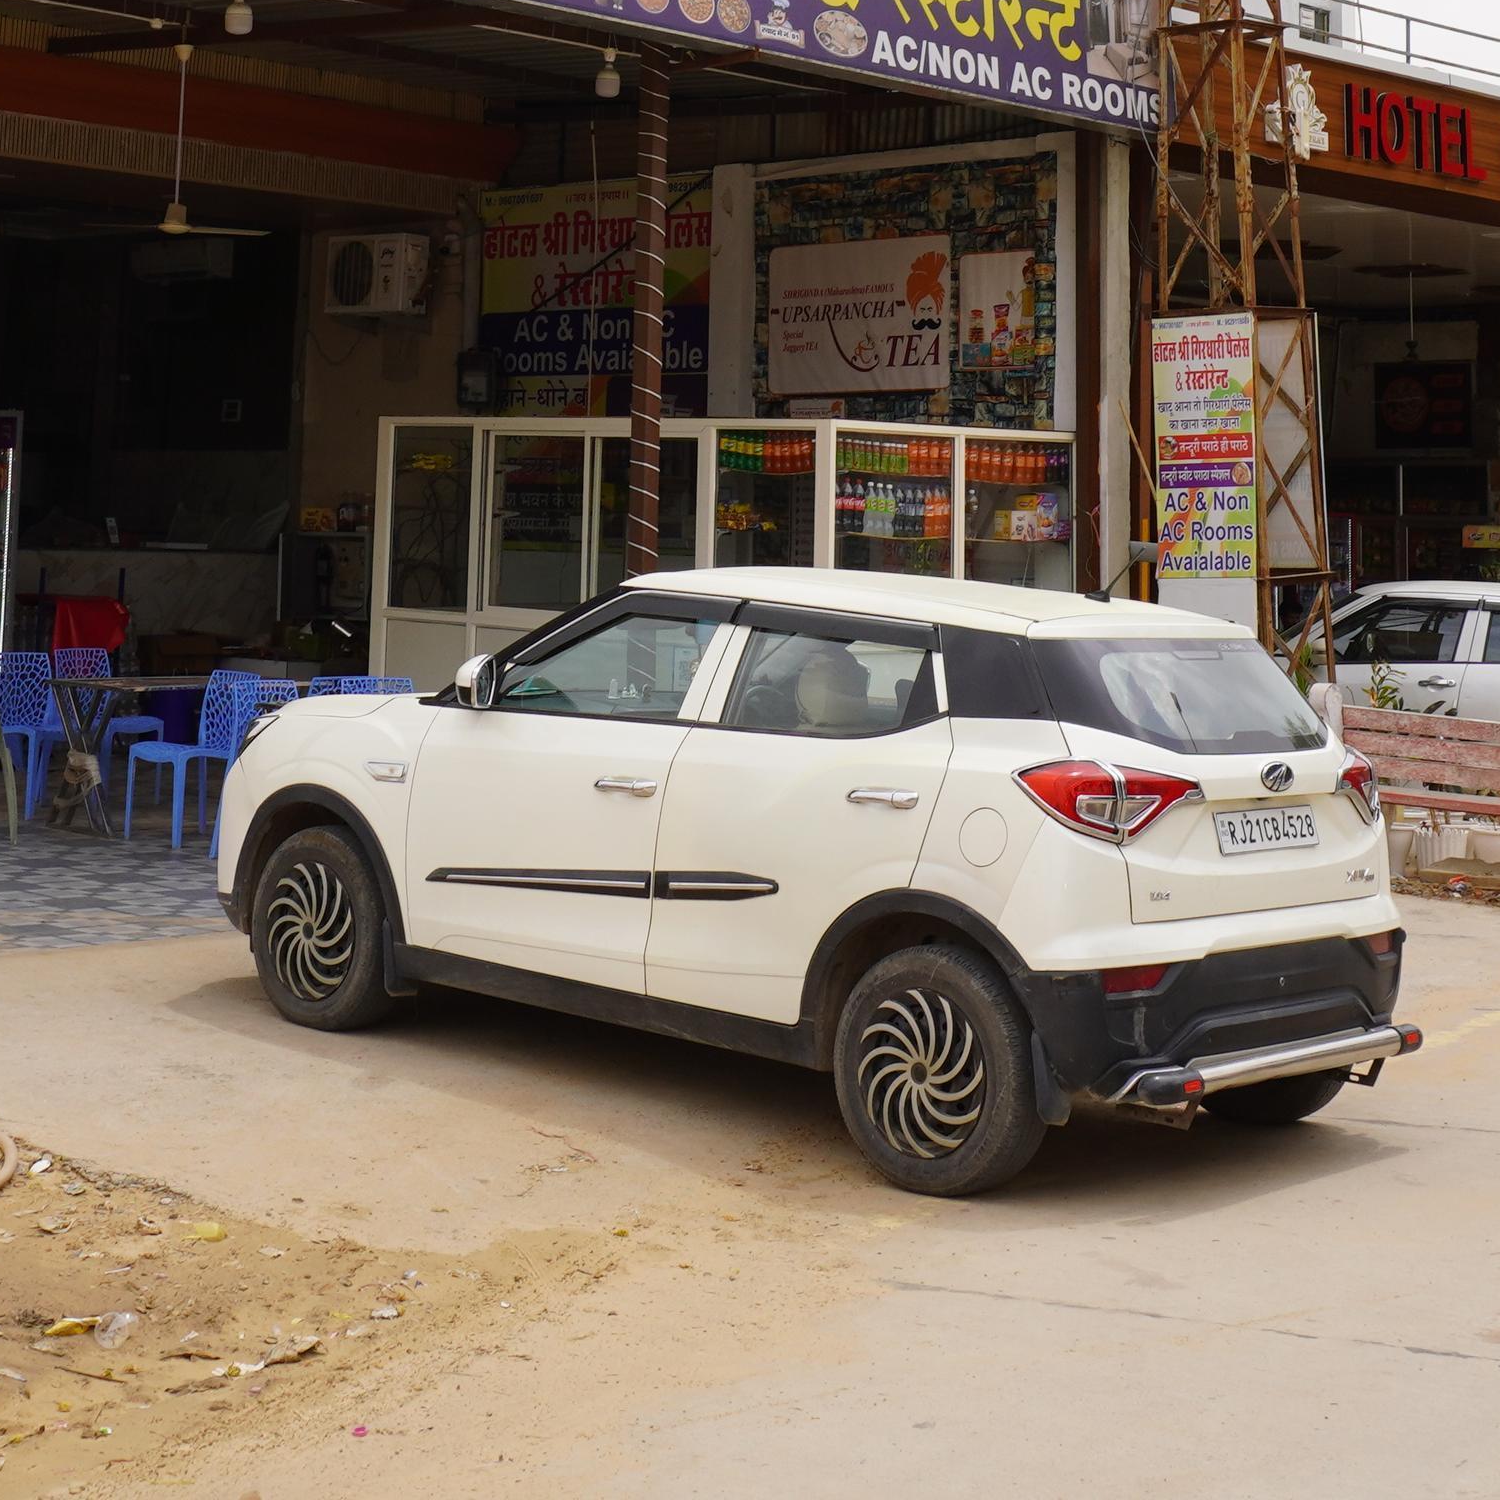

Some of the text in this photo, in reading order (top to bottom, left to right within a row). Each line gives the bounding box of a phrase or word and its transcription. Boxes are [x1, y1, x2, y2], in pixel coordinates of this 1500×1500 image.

[871, 30, 1161, 125] AC/NON AC ROOMS
[1344, 82, 1488, 182] HOTEL
[484, 215, 540, 260] होटल
[544, 211, 571, 255] श्री
[573, 210, 637, 254] गिरधा
[531, 274, 548, 308] &
[514, 315, 549, 342] AC
[556, 313, 574, 341] &
[582, 312, 631, 340] Non
[500, 347, 567, 373] ooms
[885, 334, 941, 368] TEA
[1153, 331, 1250, 362] होटल श्री गिरधारी पैलेस
[1164, 490, 1250, 512] AC & Non
[1160, 521, 1254, 542] AC Rooms
[1161, 550, 1252, 572] Avaialable
[1227, 814, 1315, 846] RJ21CB4528
